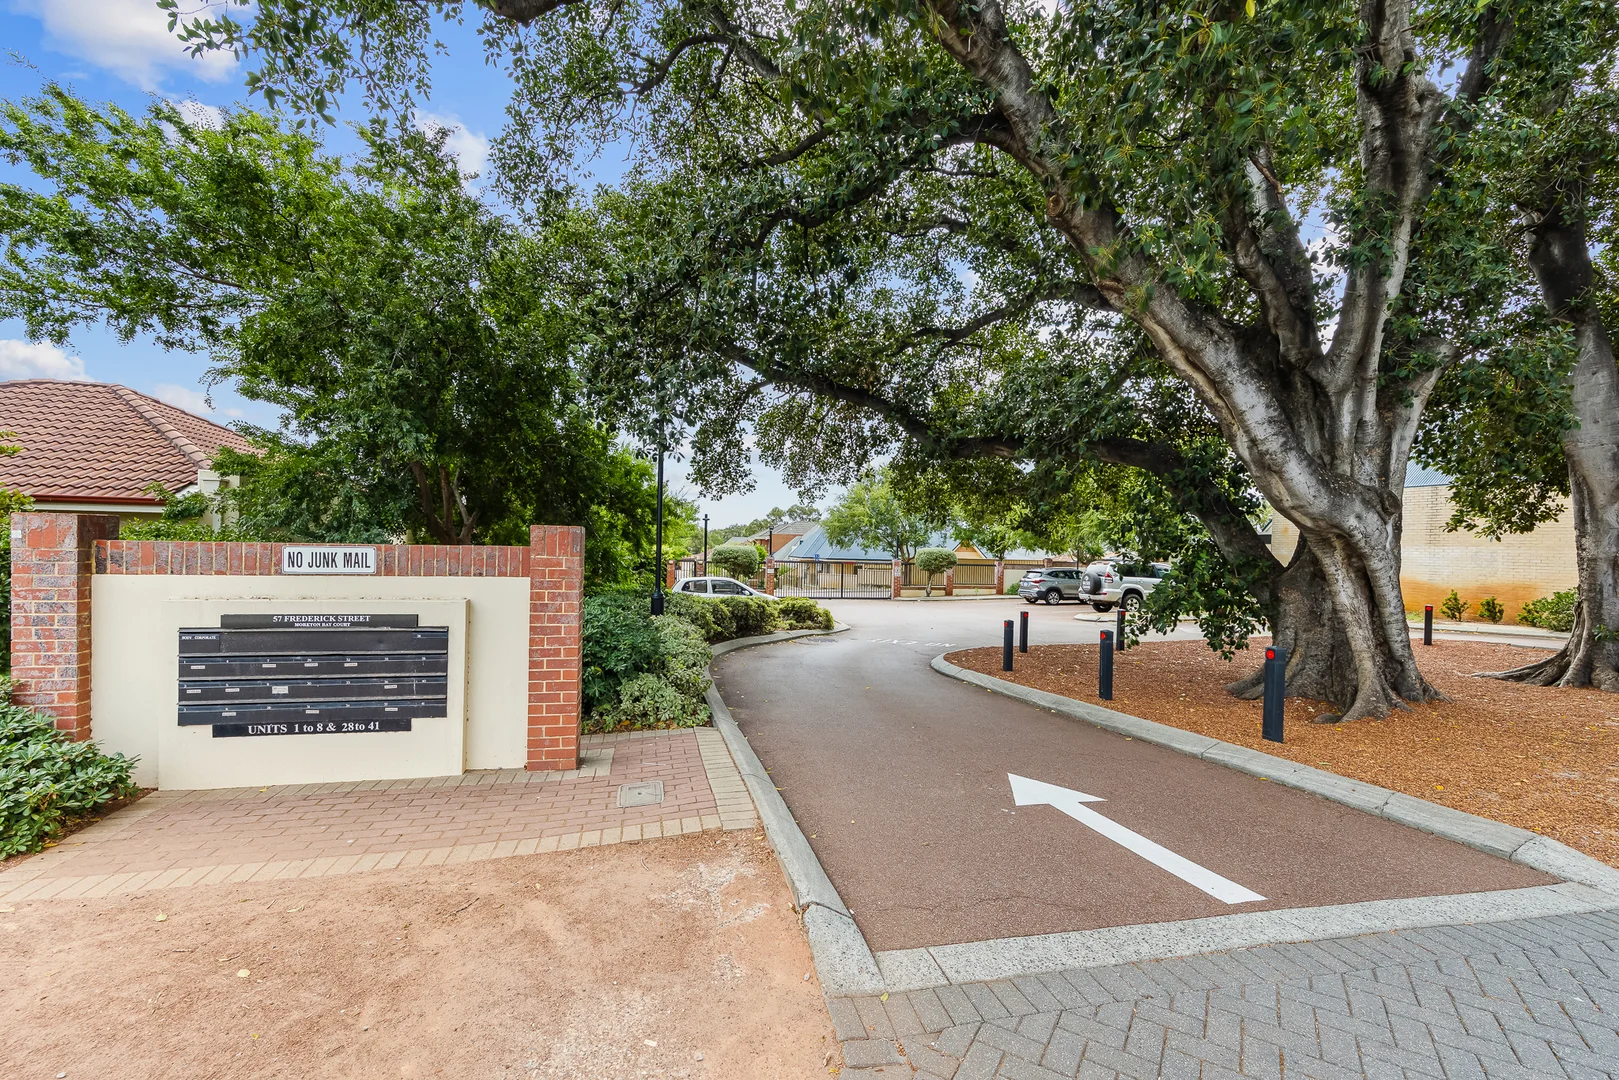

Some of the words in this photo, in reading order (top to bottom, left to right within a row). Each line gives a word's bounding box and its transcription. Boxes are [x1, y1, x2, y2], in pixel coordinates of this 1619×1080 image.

[287, 551, 303, 568] NO
[308, 551, 338, 568] JUNK
[343, 552, 371, 569] MAIL
[248, 724, 288, 734] UNITS
[303, 724, 314, 732] to
[316, 723, 323, 732] 8
[326, 722, 336, 732] &
[368, 722, 380, 730] 41
